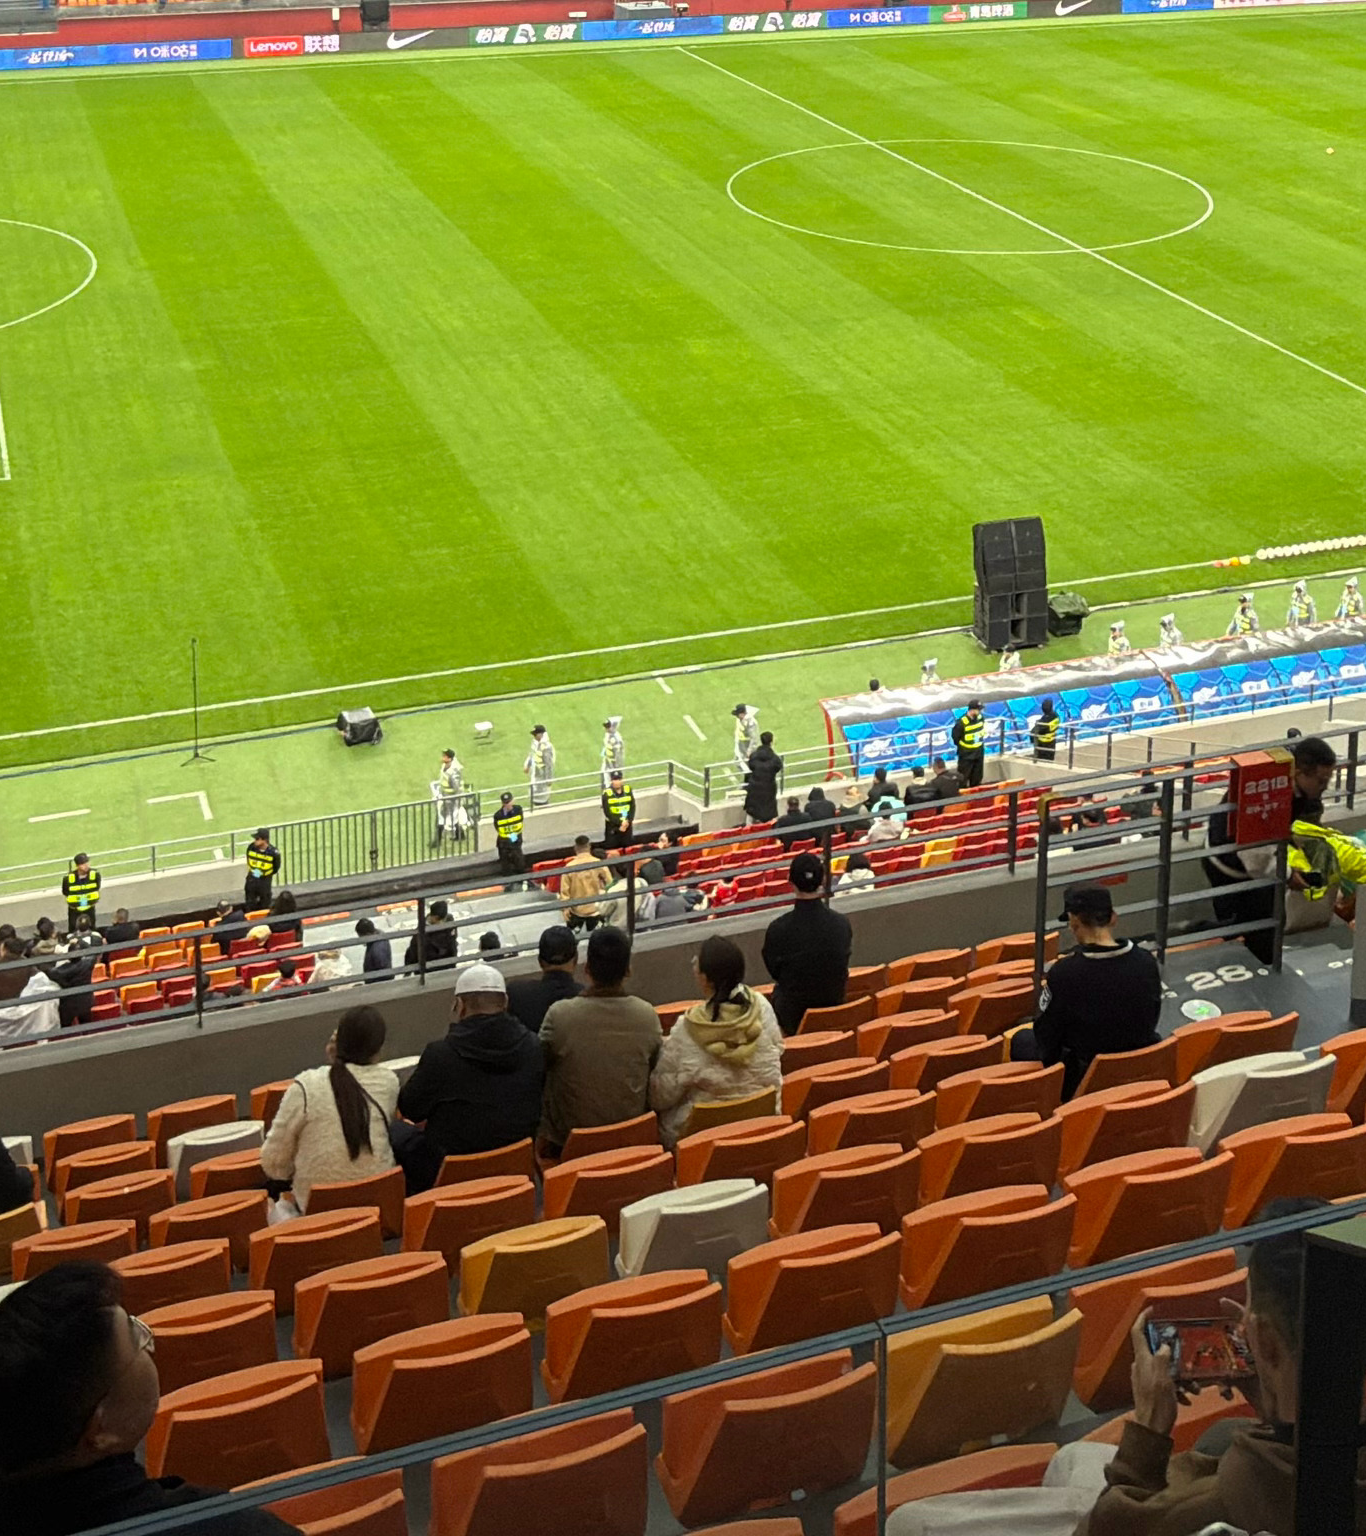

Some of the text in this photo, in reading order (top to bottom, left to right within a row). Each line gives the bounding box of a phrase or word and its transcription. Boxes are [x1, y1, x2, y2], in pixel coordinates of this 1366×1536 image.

[249, 39, 298, 54] Lenovo
[304, 35, 340, 53] 联想
[1244, 775, 1289, 795] 221B
